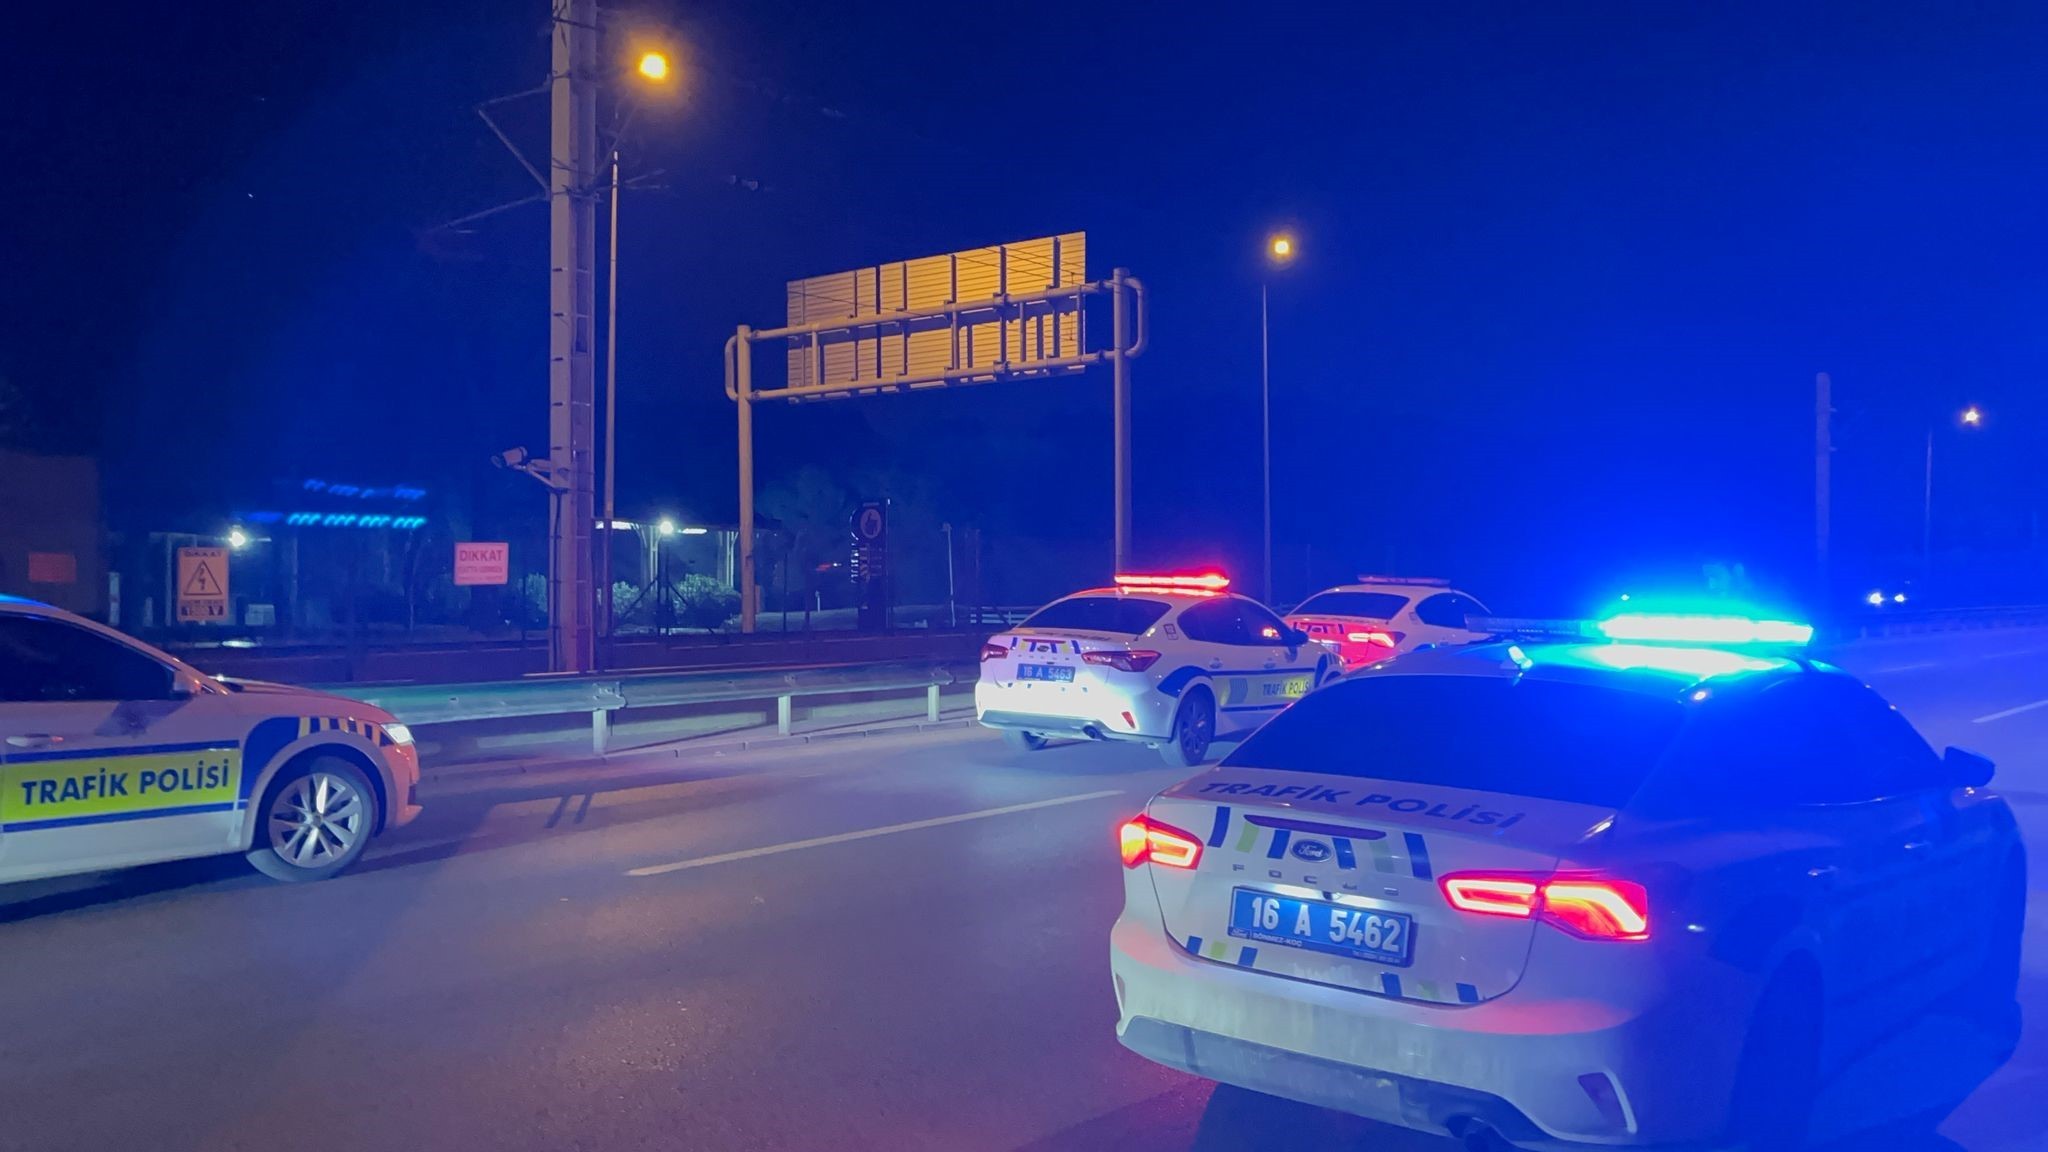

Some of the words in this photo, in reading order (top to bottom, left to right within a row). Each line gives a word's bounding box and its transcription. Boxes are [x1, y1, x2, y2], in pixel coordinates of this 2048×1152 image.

[1023, 666, 1033, 677] 16
[1035, 668, 1044, 678] A
[21, 767, 128, 805] TRAFİK
[139, 758, 229, 794] POLİSİ
[1199, 783, 1349, 803] TRAFİK
[1355, 792, 1526, 828] POLİSİ
[1252, 897, 1280, 930] 16
[1294, 904, 1312, 937] A
[1329, 909, 1401, 952] 5462
